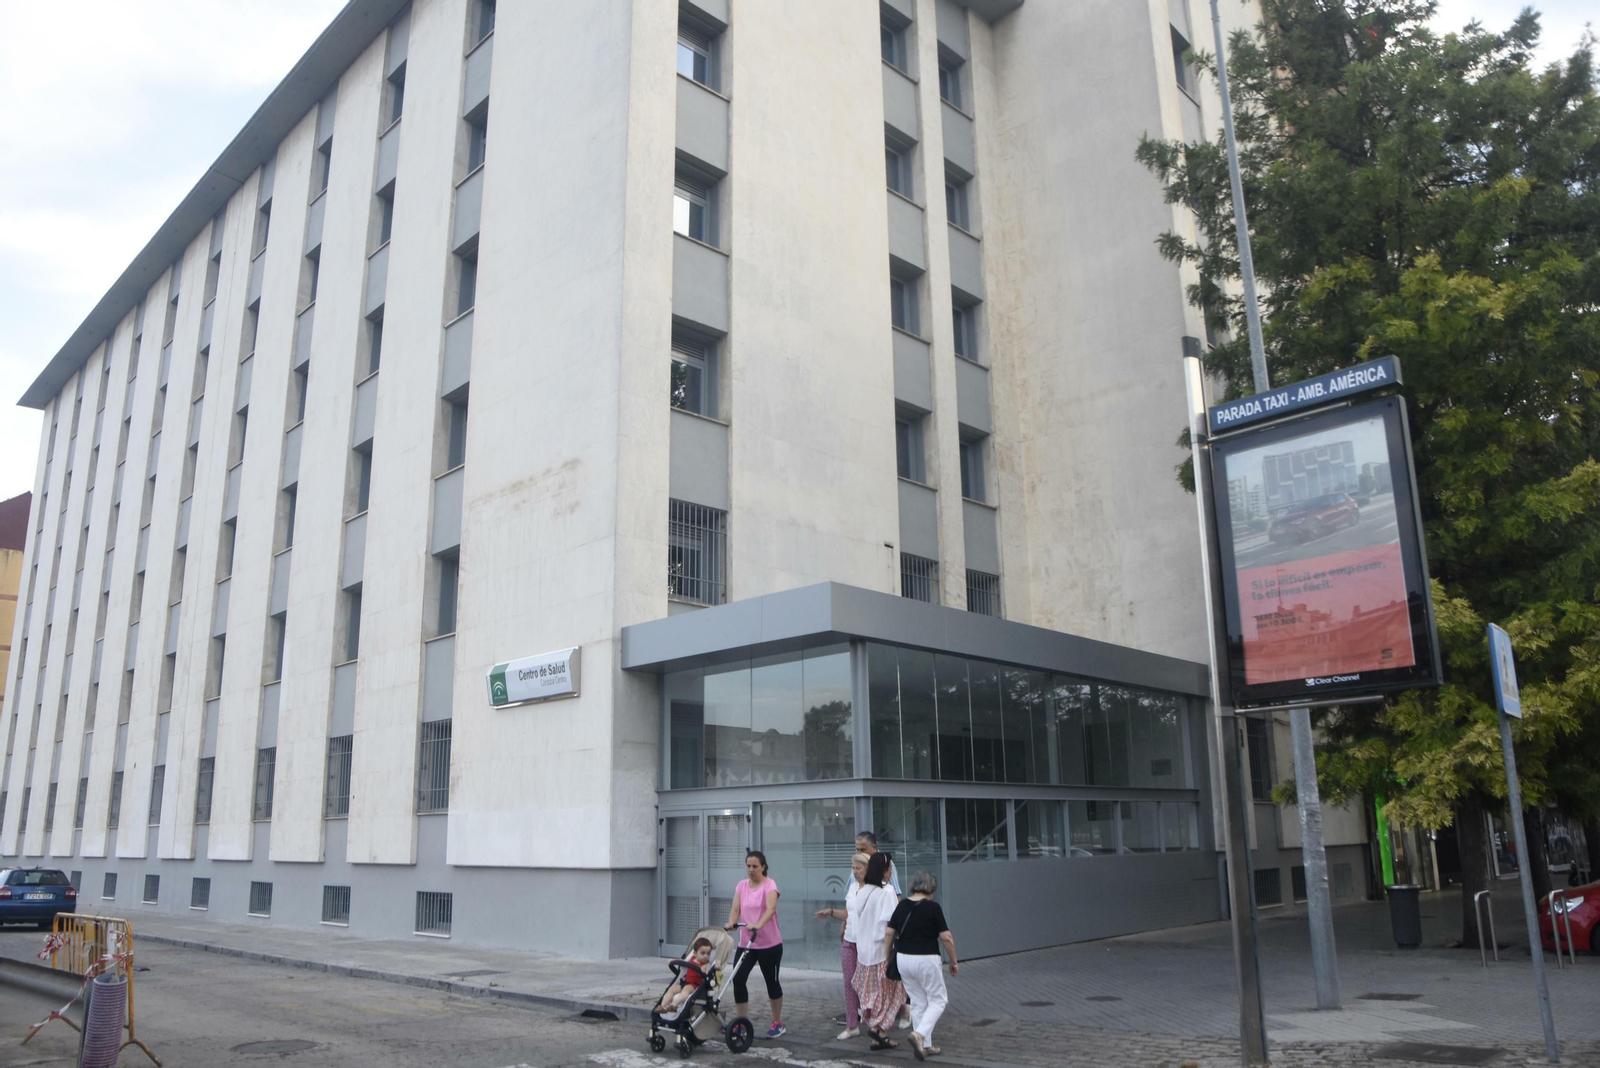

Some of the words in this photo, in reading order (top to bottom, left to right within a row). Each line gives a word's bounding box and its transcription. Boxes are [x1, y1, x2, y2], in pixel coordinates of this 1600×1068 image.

[1217, 400, 1262, 424] PARADA
[1263, 392, 1289, 411] TAXI
[1298, 383, 1327, 402] AMB.
[1329, 365, 1387, 393] AMÉRICA
[1251, 580, 1263, 590] Si
[1265, 578, 1276, 588] lo
[1313, 570, 1327, 580] es
[1252, 590, 1264, 600] lo
[1265, 585, 1302, 598] tienes
[519, 670, 538, 681] Centro
[540, 666, 547, 676] de
[548, 662, 565, 675] Salud
[1315, 675, 1332, 685] Clear
[1333, 674, 1360, 683] Channel
